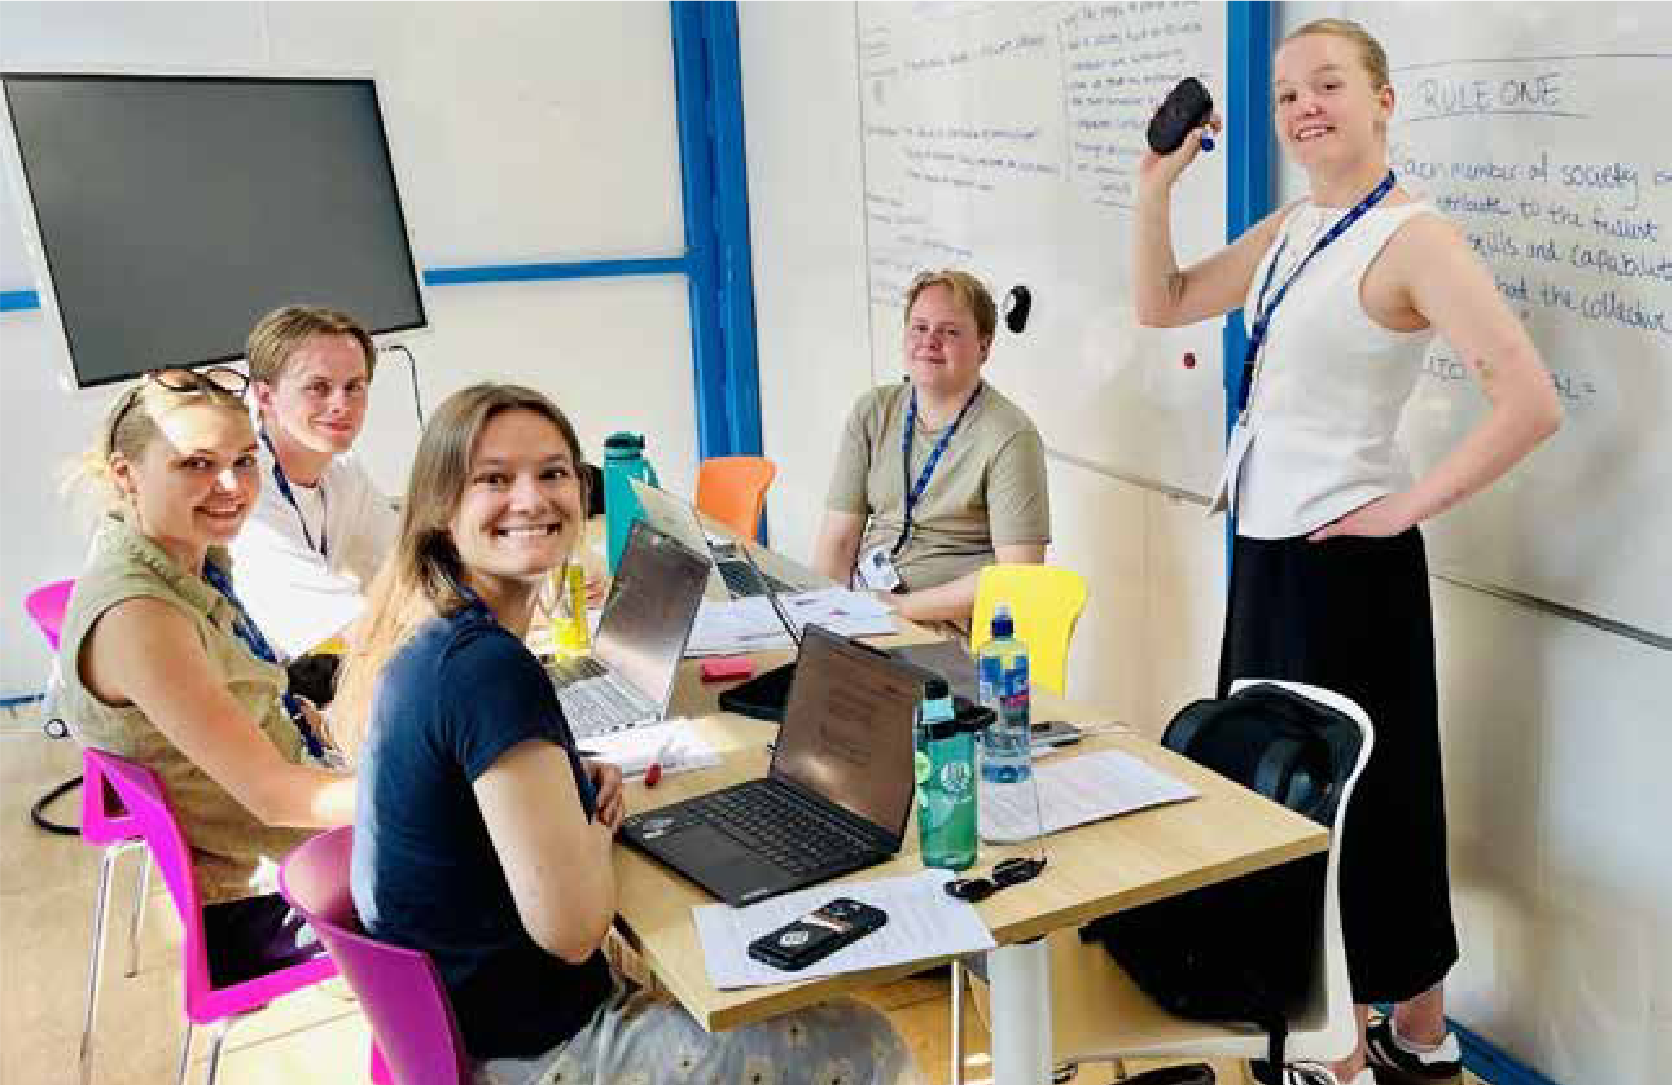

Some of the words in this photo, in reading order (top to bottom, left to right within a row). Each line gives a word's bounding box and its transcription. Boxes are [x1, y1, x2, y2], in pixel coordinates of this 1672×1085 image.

[1414, 80, 1494, 112] RULE
[1502, 72, 1563, 107] ONE
[1529, 150, 1549, 183] of
[1560, 161, 1640, 211] society
[1520, 200, 1541, 220] to
[1540, 281, 1577, 310] the
